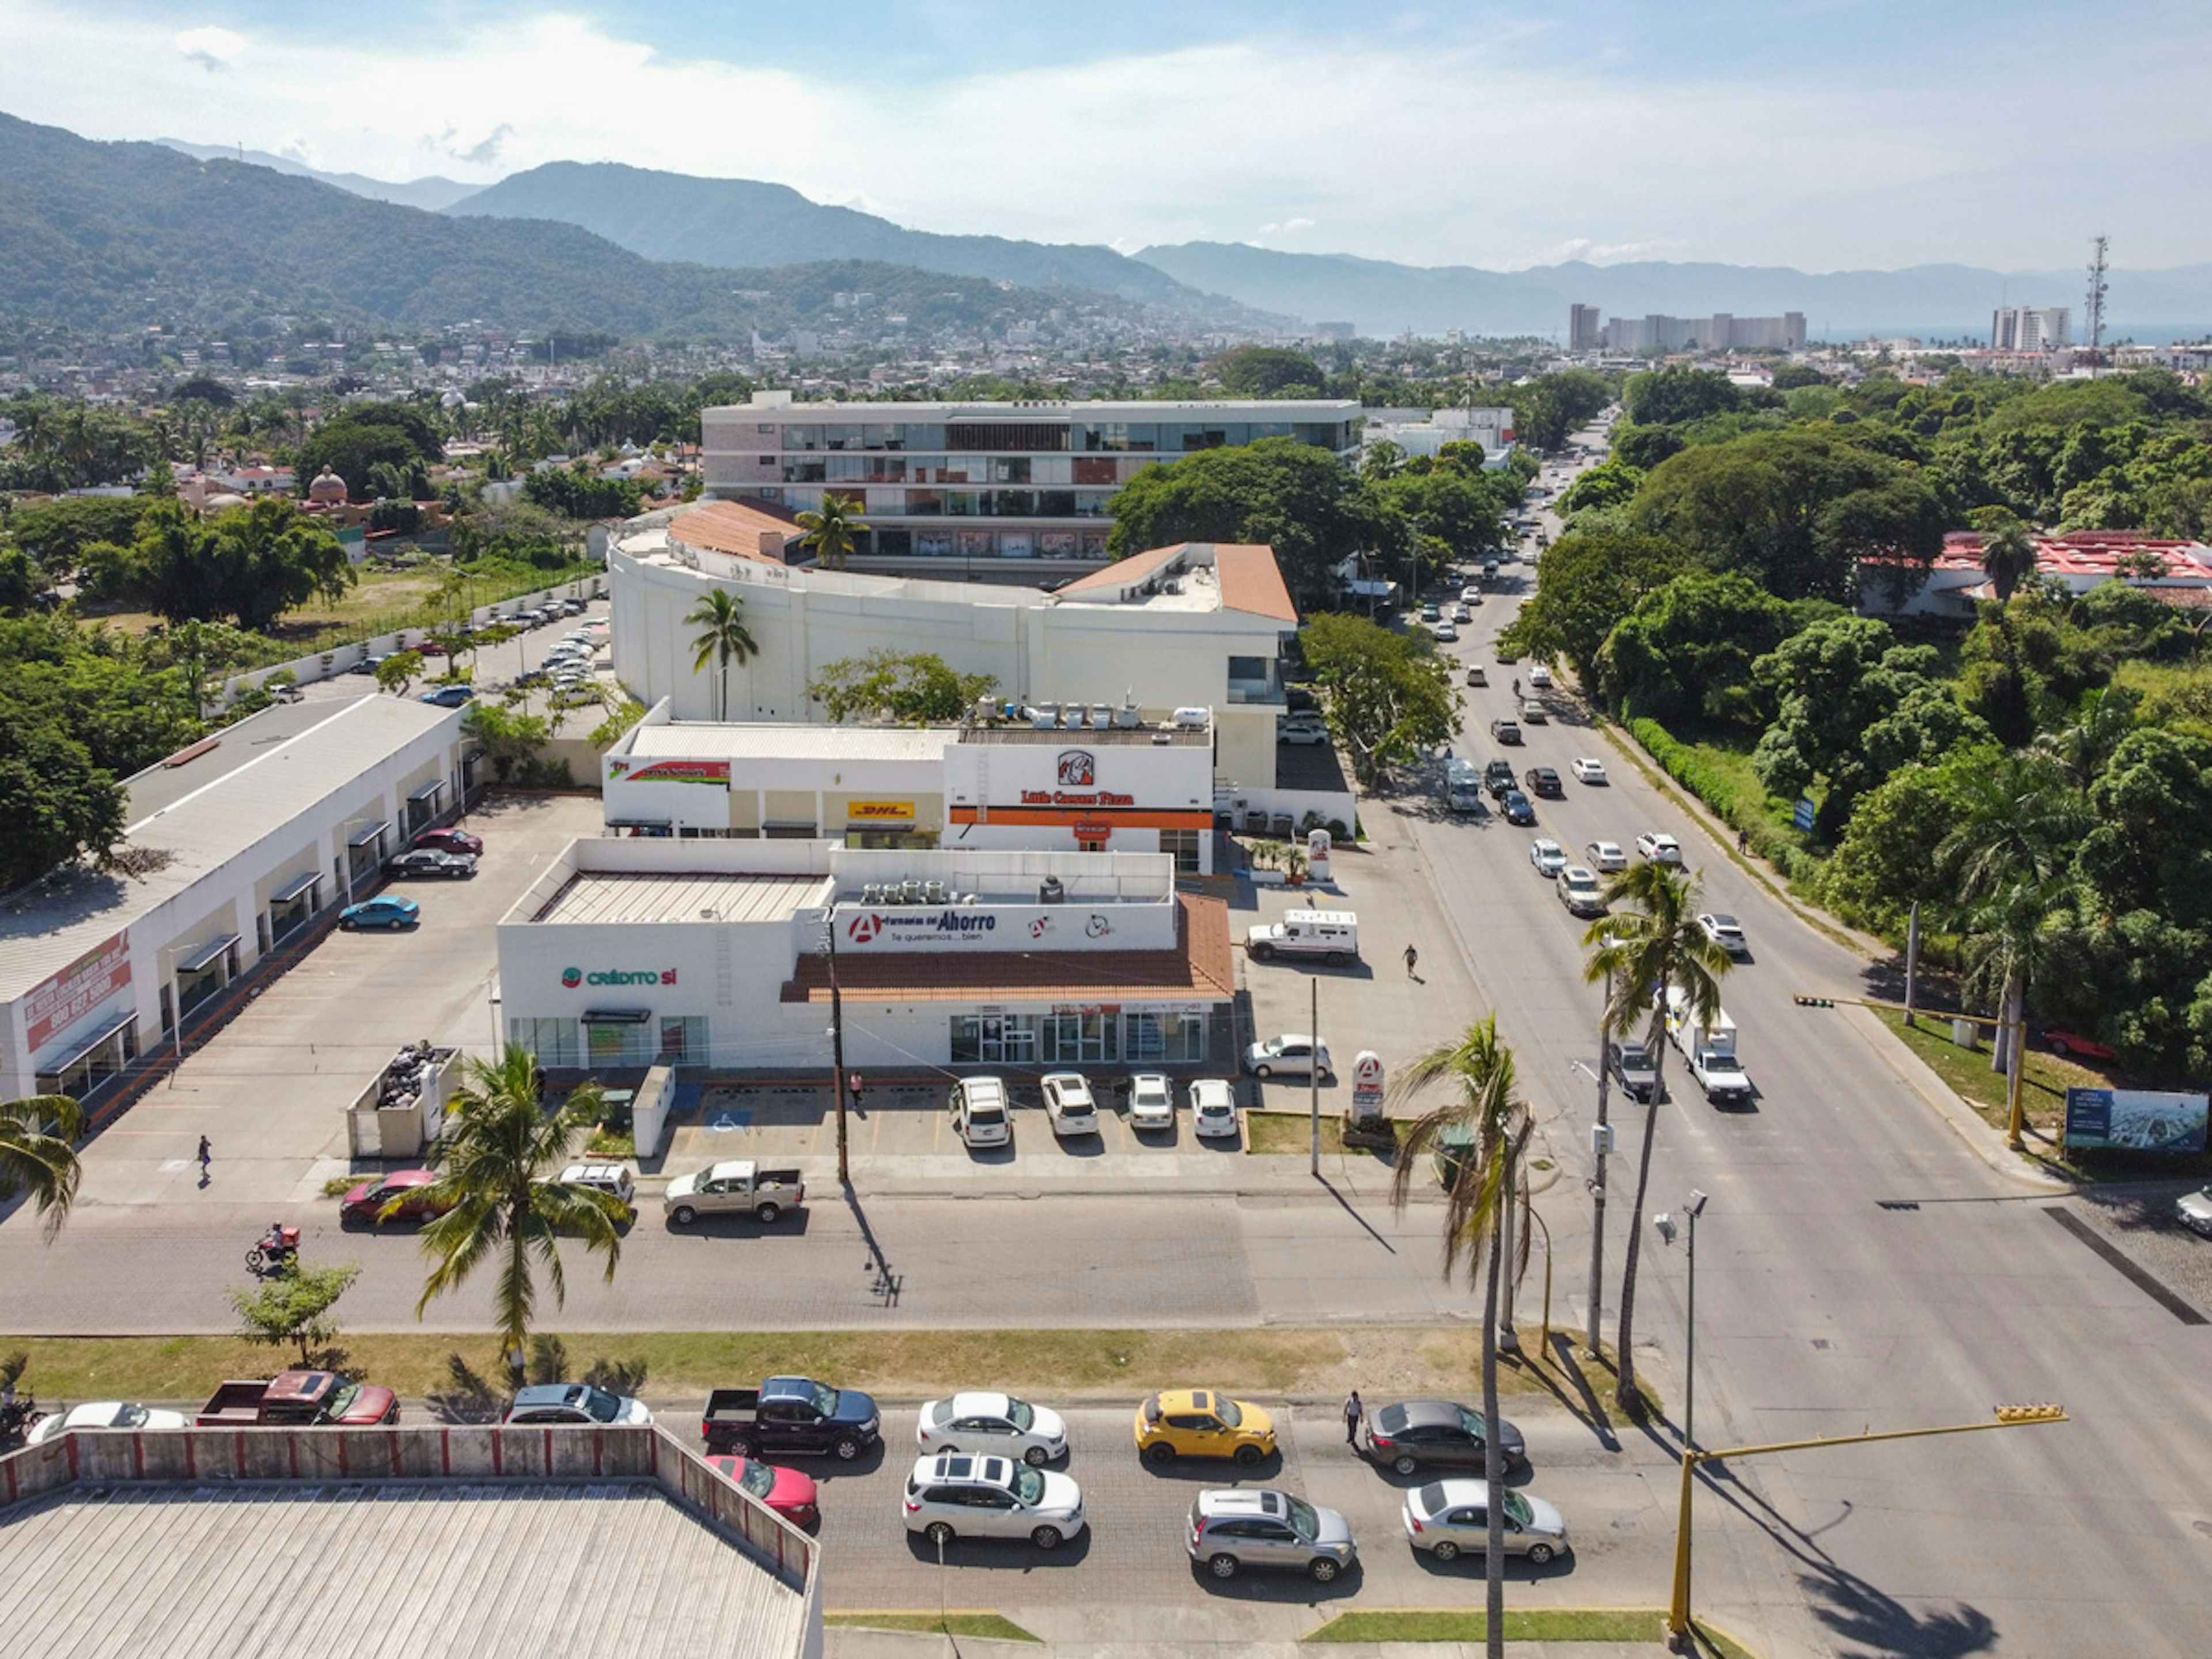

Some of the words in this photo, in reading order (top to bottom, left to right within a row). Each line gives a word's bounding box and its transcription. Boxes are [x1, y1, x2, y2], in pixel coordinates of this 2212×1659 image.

[1099, 791, 1134, 805] Pizza
[862, 805, 899, 815] DHL
[937, 911, 995, 931] Ahorro
